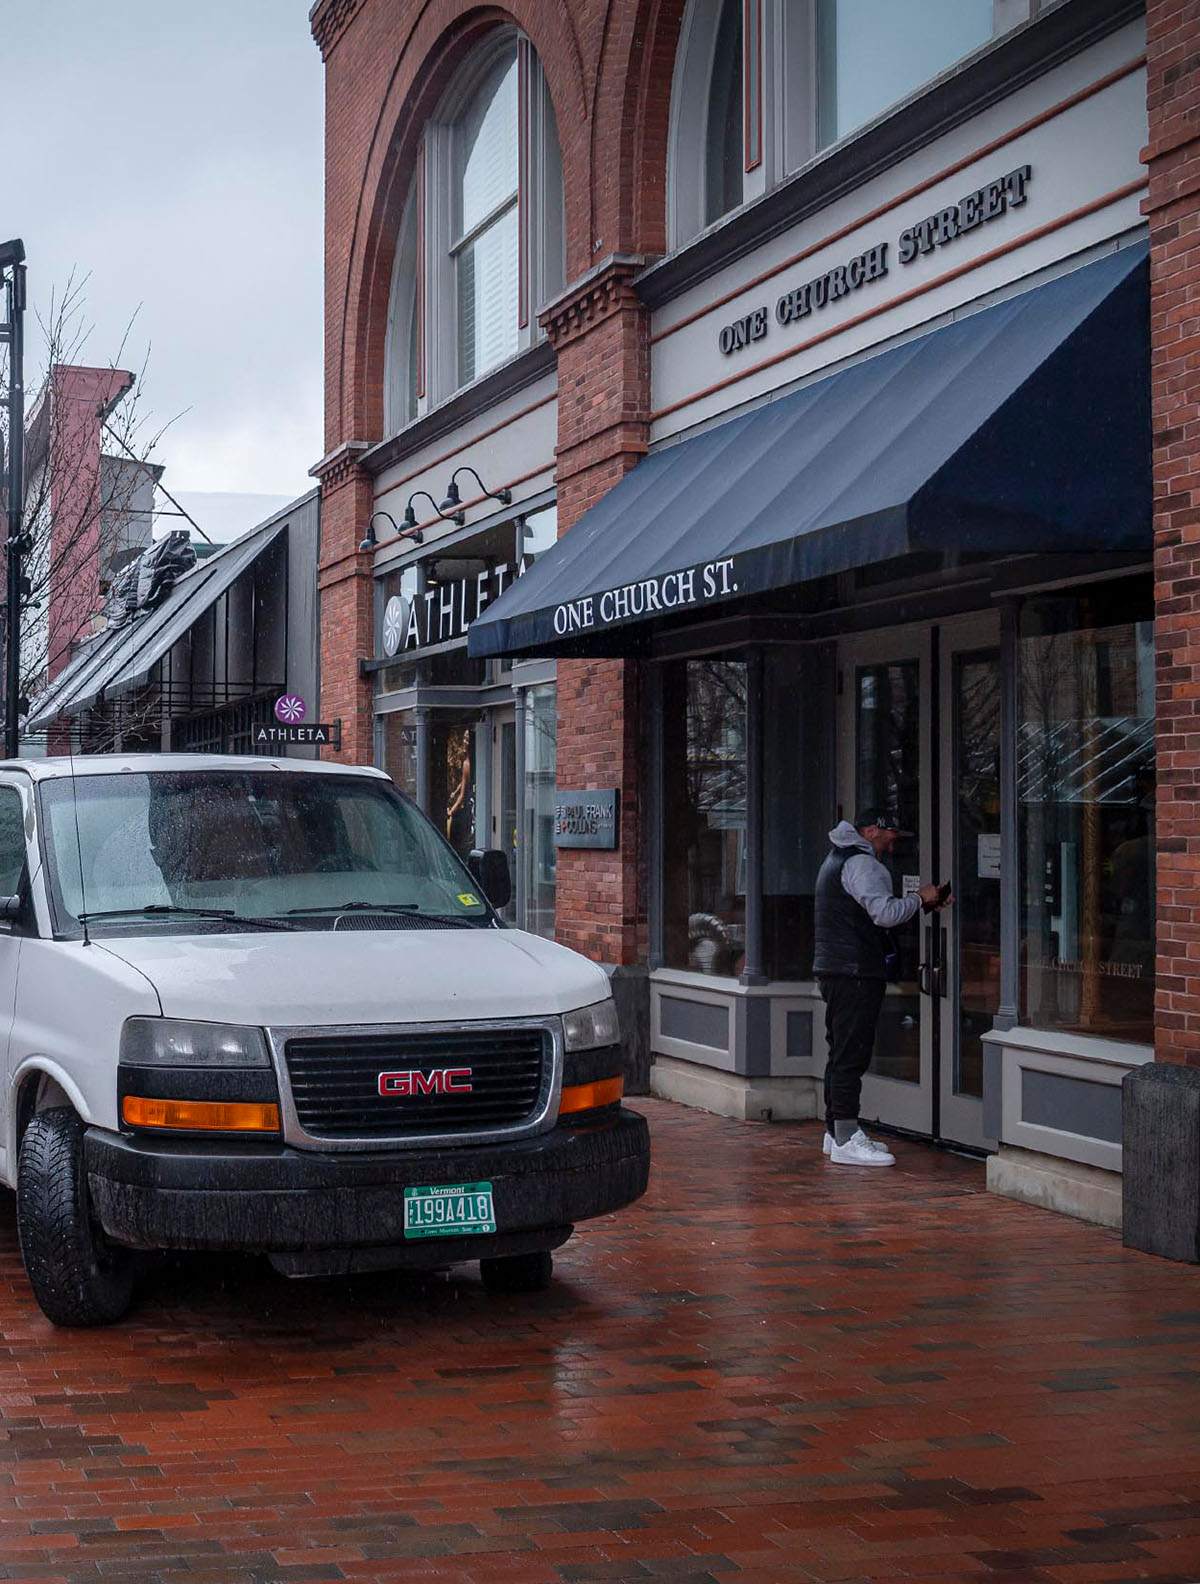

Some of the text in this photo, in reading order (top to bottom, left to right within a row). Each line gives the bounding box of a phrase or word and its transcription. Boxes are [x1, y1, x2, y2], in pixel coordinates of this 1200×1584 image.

[718, 164, 1032, 355] ONE CHURCH STREET
[553, 558, 738, 635] ONE CHURCH ST.
[257, 728, 326, 741] ATHLETA
[585, 804, 613, 818] FRANK
[378, 1068, 473, 1096] GMC
[429, 1186, 465, 1196] Vermont
[415, 1195, 489, 1225] 199A418
